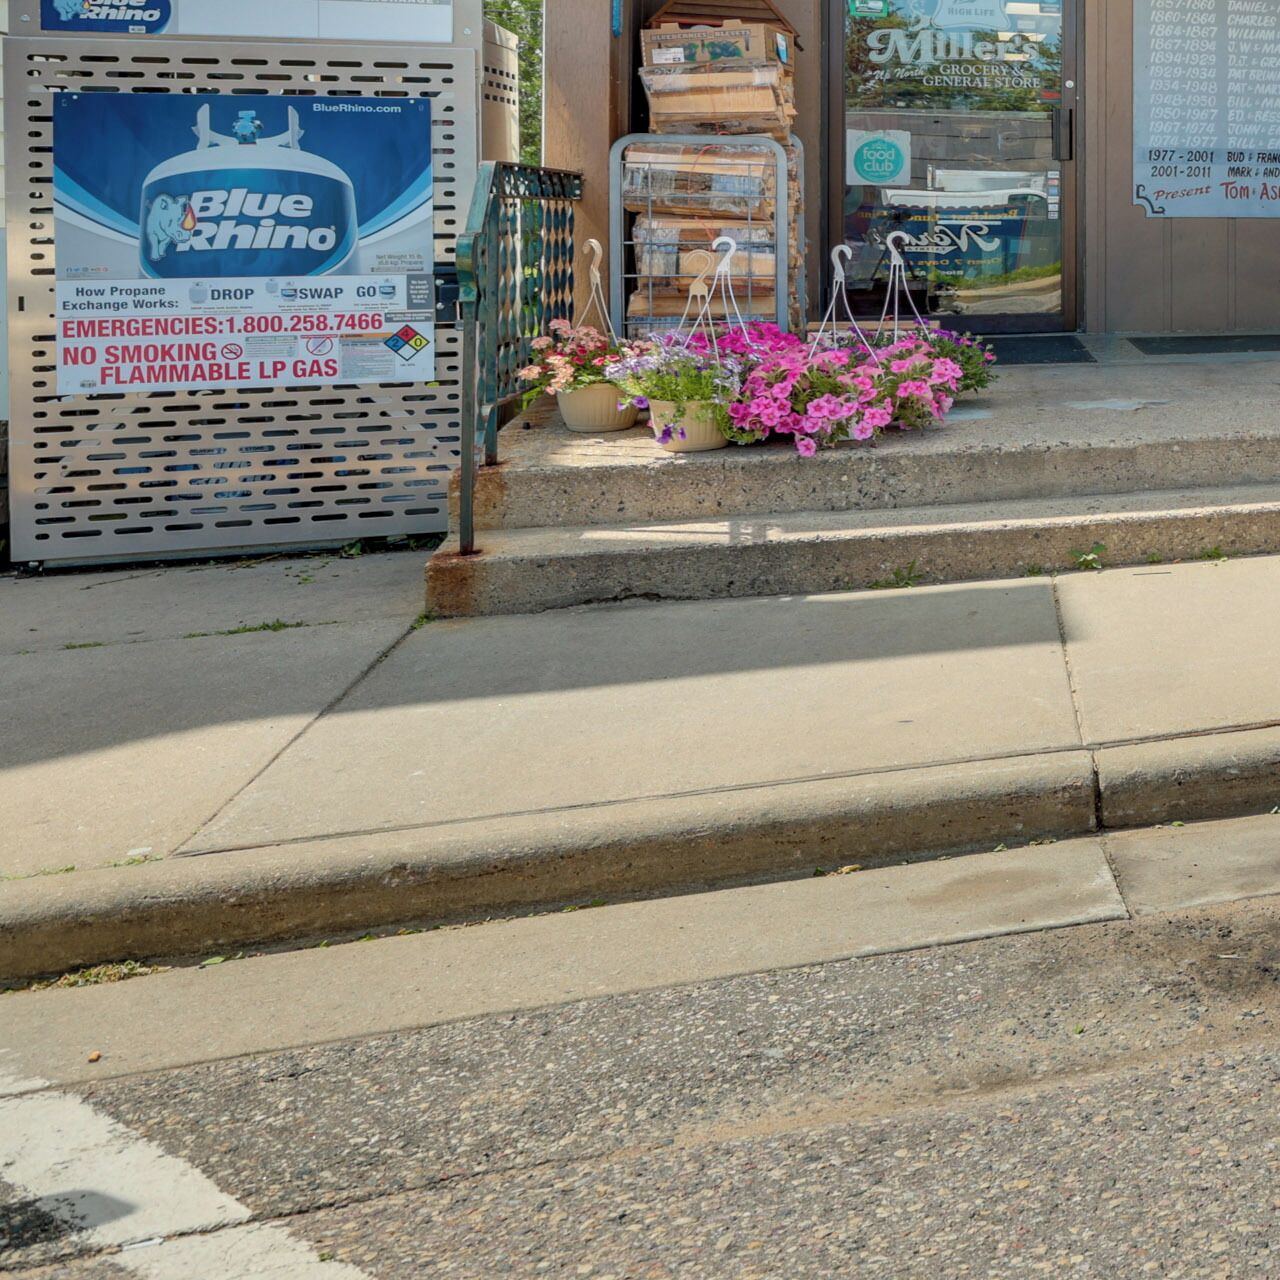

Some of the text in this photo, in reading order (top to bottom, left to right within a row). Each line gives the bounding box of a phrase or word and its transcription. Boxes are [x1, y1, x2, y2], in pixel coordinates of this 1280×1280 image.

[948, 8, 995, 17] HIGH LIFE
[1227, 0, 1267, 12] DANIEL
[80, 6, 160, 22] Rhino
[1227, 14, 1277, 27] CHARLES
[866, 28, 1040, 65] Miller's
[940, 64, 1010, 76] GROCERY
[923, 75, 1040, 89] GENERAL STORE
[312, 103, 401, 113] BlueRhino.com
[863, 149, 895, 161] food
[1149, 150, 1175, 162] 1977
[1187, 151, 1214, 163] 2001
[1227, 152, 1245, 162] BUD
[863, 160, 894, 172] club
[1227, 167, 1252, 178] MARK
[1153, 186, 1211, 201] Present
[190, 188, 313, 218] Blue
[176, 218, 334, 252] Rhino
[75, 286, 166, 298] How Propane
[210, 286, 377, 301] DROP SWAP GO
[62, 299, 179, 311] Exchange Works:
[391, 338, 421, 347] 2 0
[63, 342, 217, 366] NO SMOKING
[100, 358, 338, 385] FLAMMABLE LP GAS
